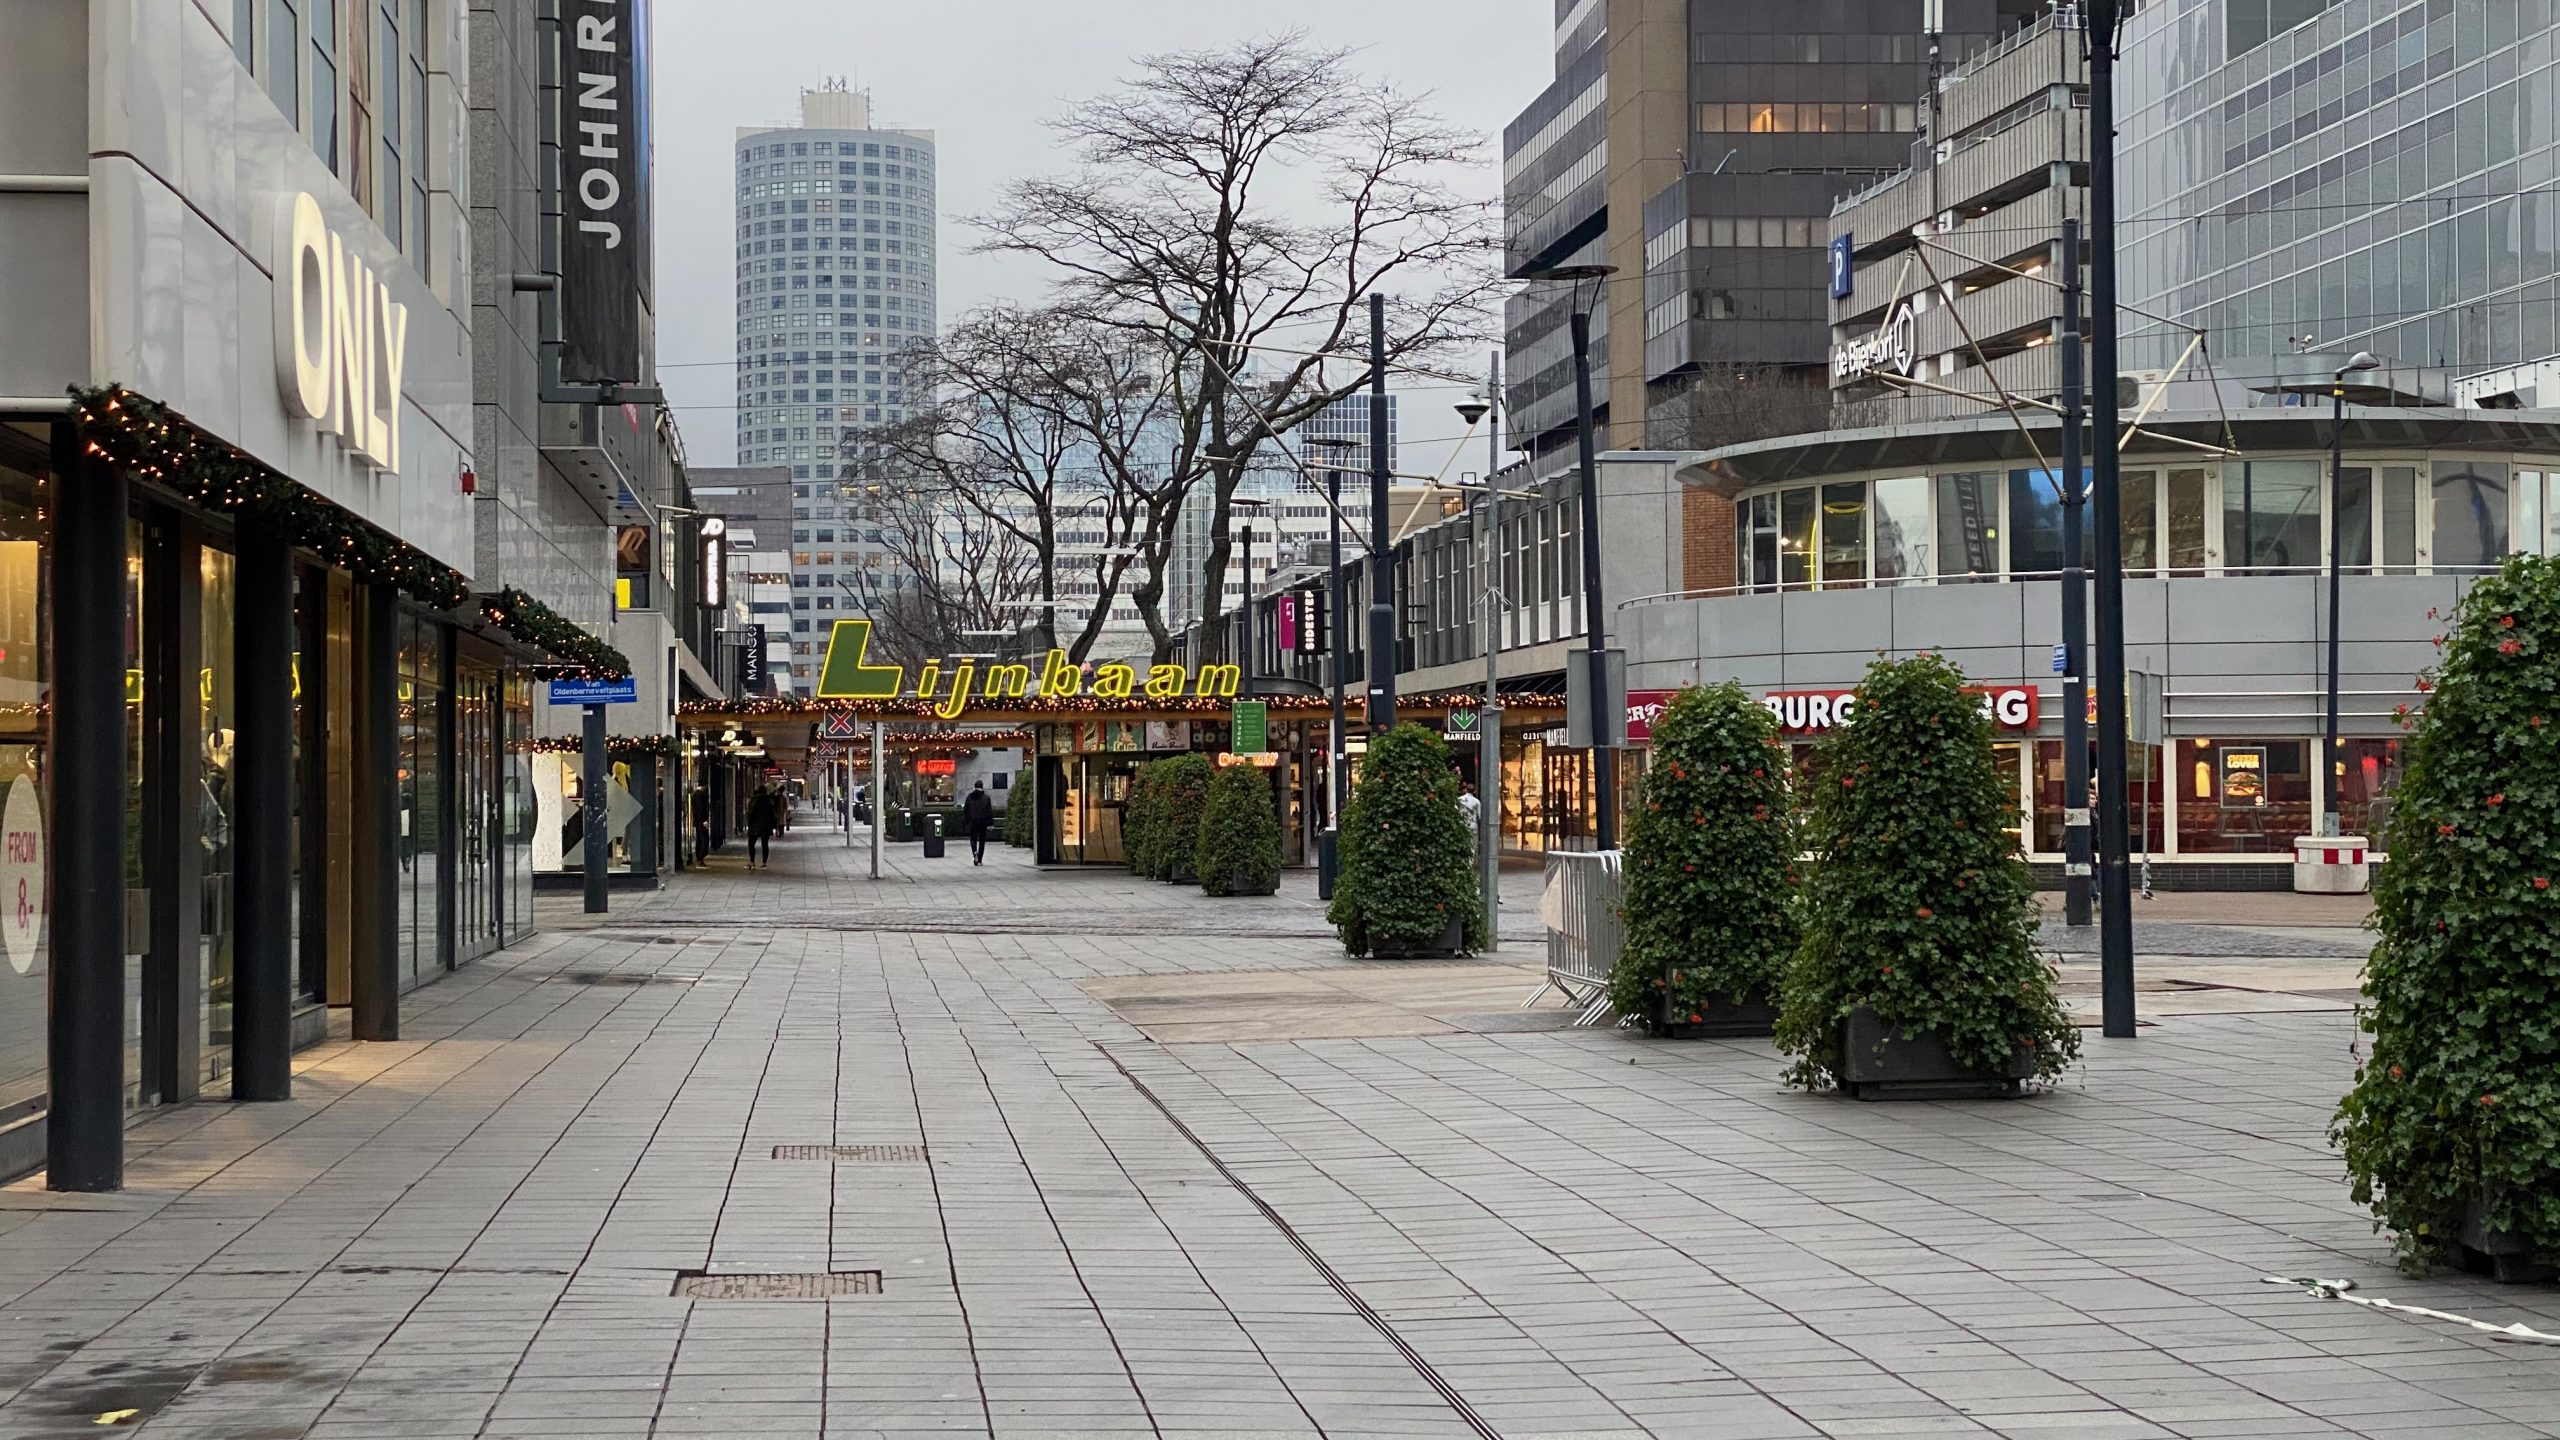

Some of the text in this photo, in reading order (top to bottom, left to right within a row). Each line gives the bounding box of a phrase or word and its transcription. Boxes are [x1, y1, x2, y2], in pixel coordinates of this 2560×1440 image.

[576, 0, 622, 250] JOHN R
[1834, 250, 1843, 291] P
[292, 190, 408, 476] ONLY
[1834, 345, 1848, 378] de
[700, 517, 725, 536] JD
[1304, 590, 1315, 650] SIDESTEP
[747, 625, 758, 681] MANGO
[816, 618, 1242, 720] Lijnbaan
[1763, 693, 1858, 729] BURG
[1443, 732, 1481, 741] MANFIELD
[8, 831, 37, 864] FROM
